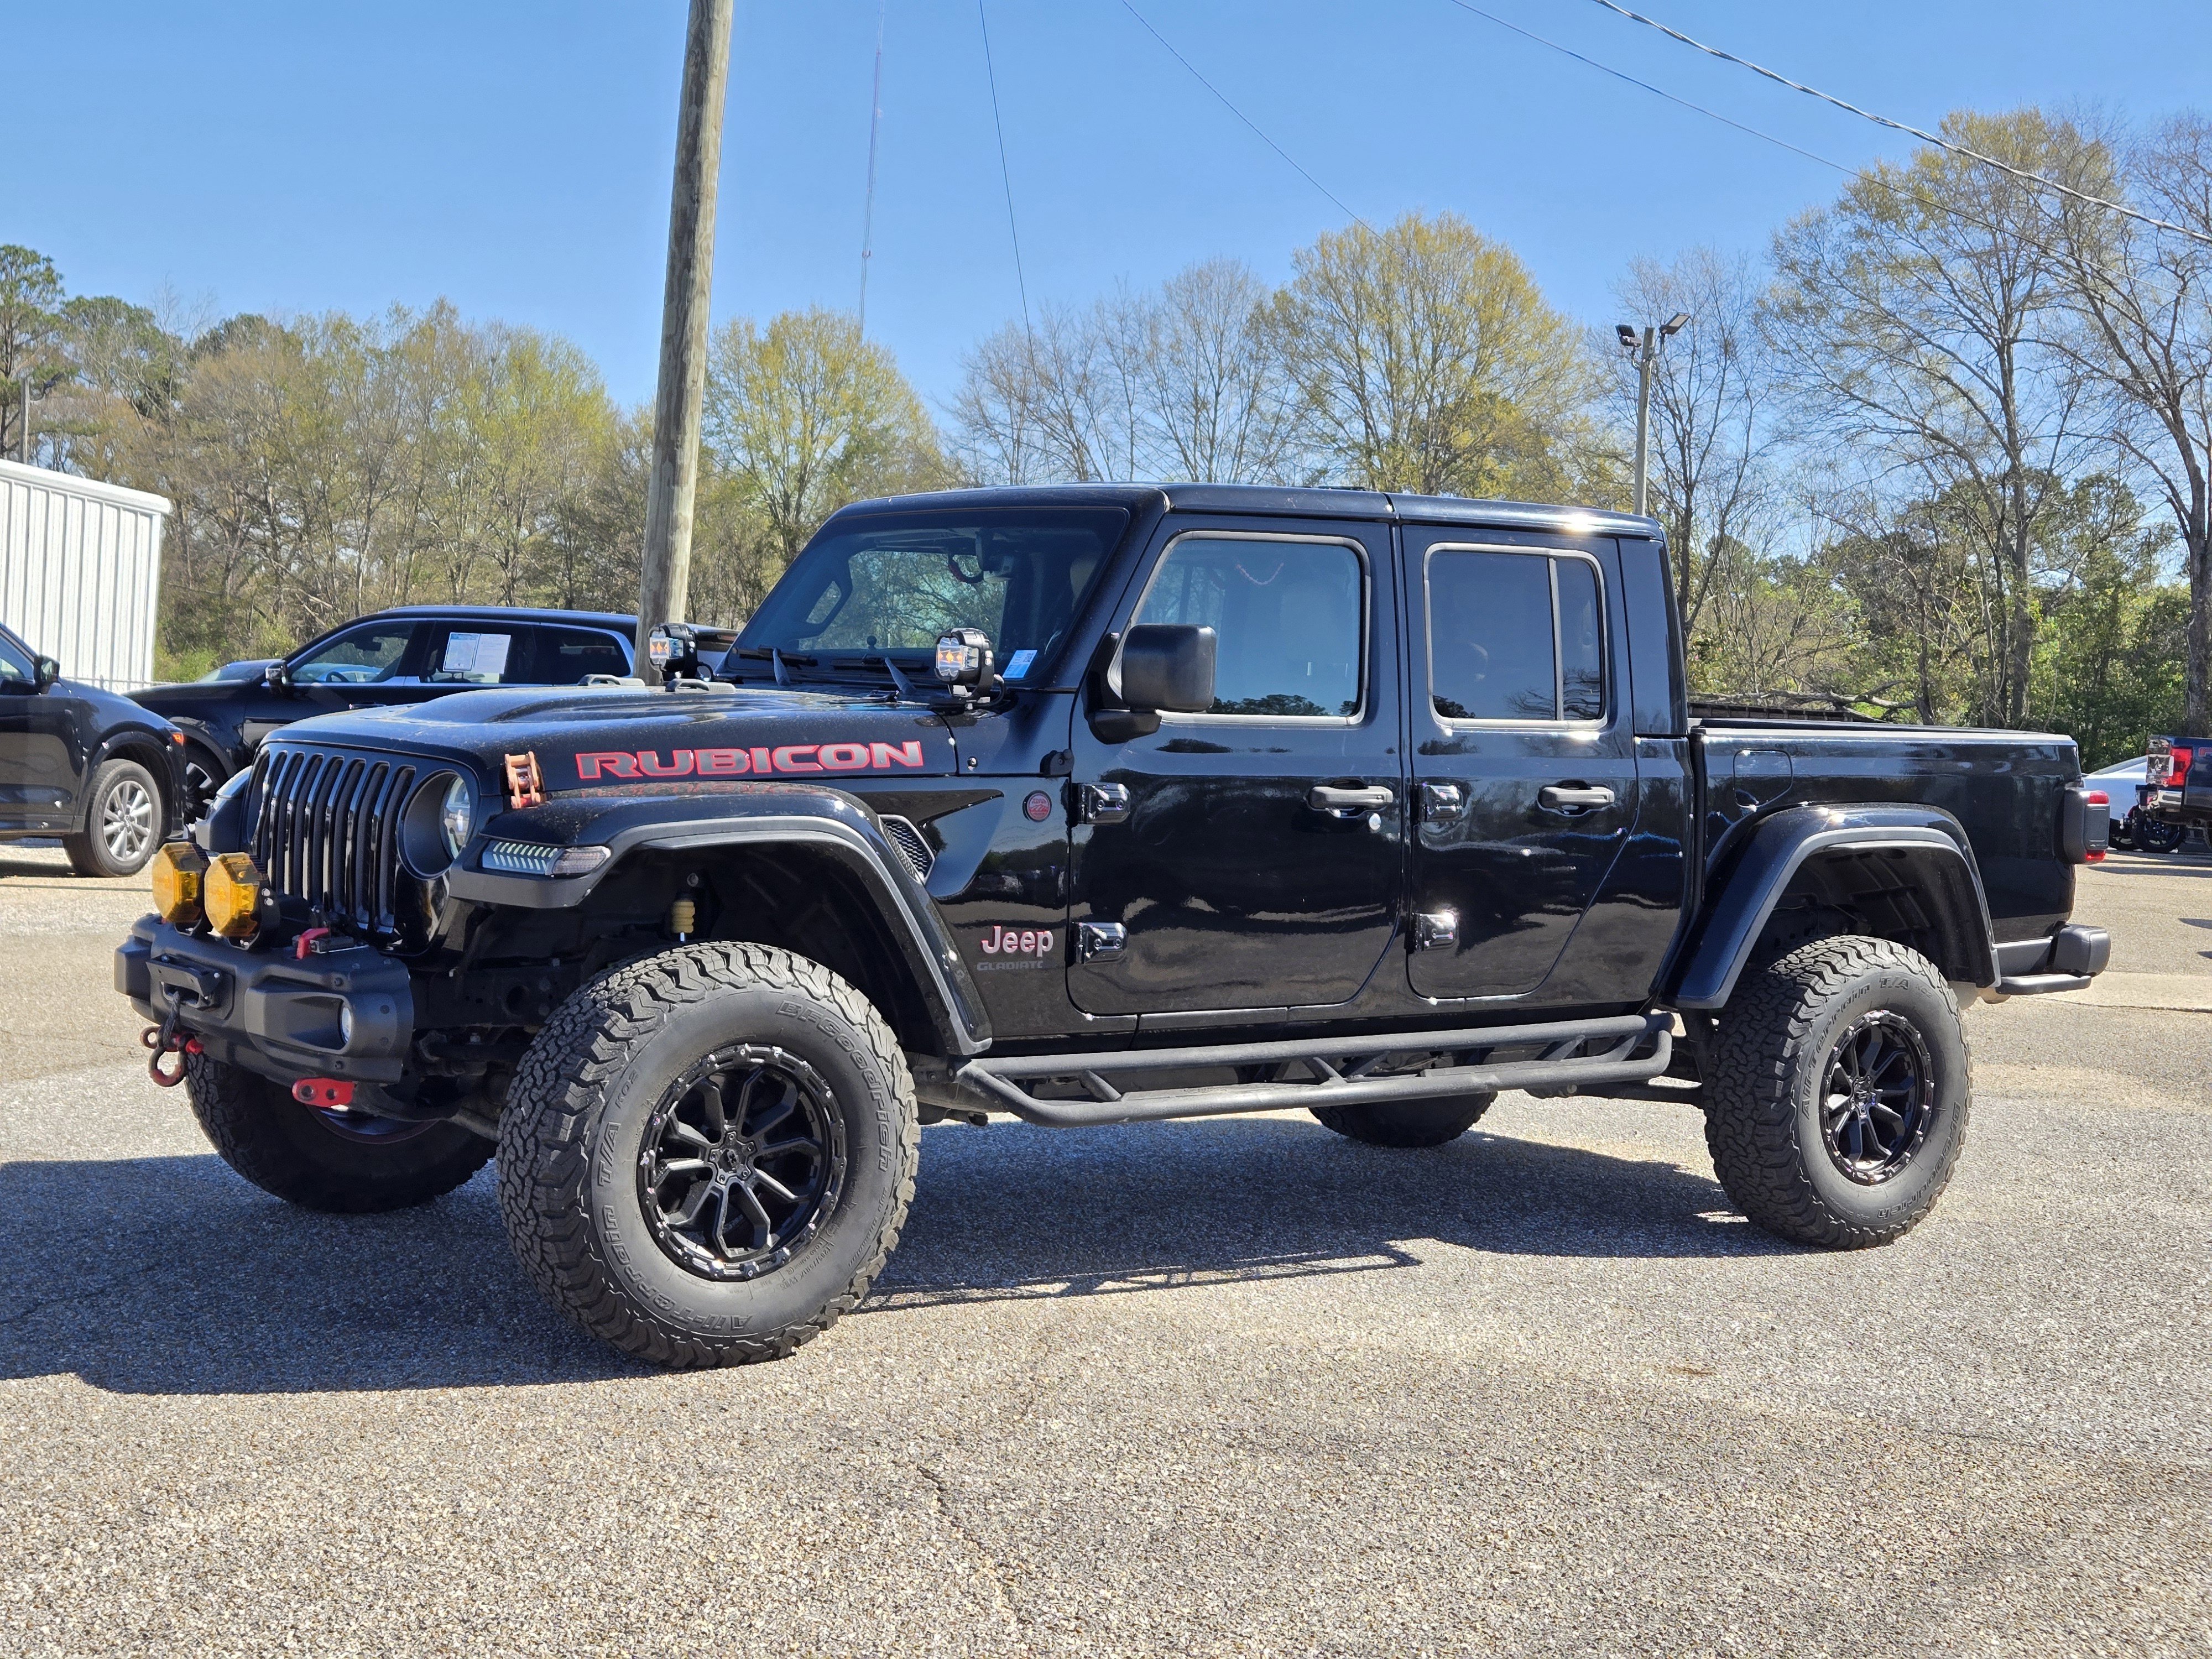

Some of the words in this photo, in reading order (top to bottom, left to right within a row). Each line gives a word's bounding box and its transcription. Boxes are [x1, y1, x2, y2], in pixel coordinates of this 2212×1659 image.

[576, 741, 924, 779] RUBICON
[980, 925, 1053, 958] Jeep
[615, 1069, 638, 1109] KO2
[776, 1000, 893, 1172] BFGoodrich
[597, 1121, 621, 1187] T/A
[1877, 1101, 1961, 1220] BFGoodrich
[599, 1205, 753, 1331] All-Terrain
